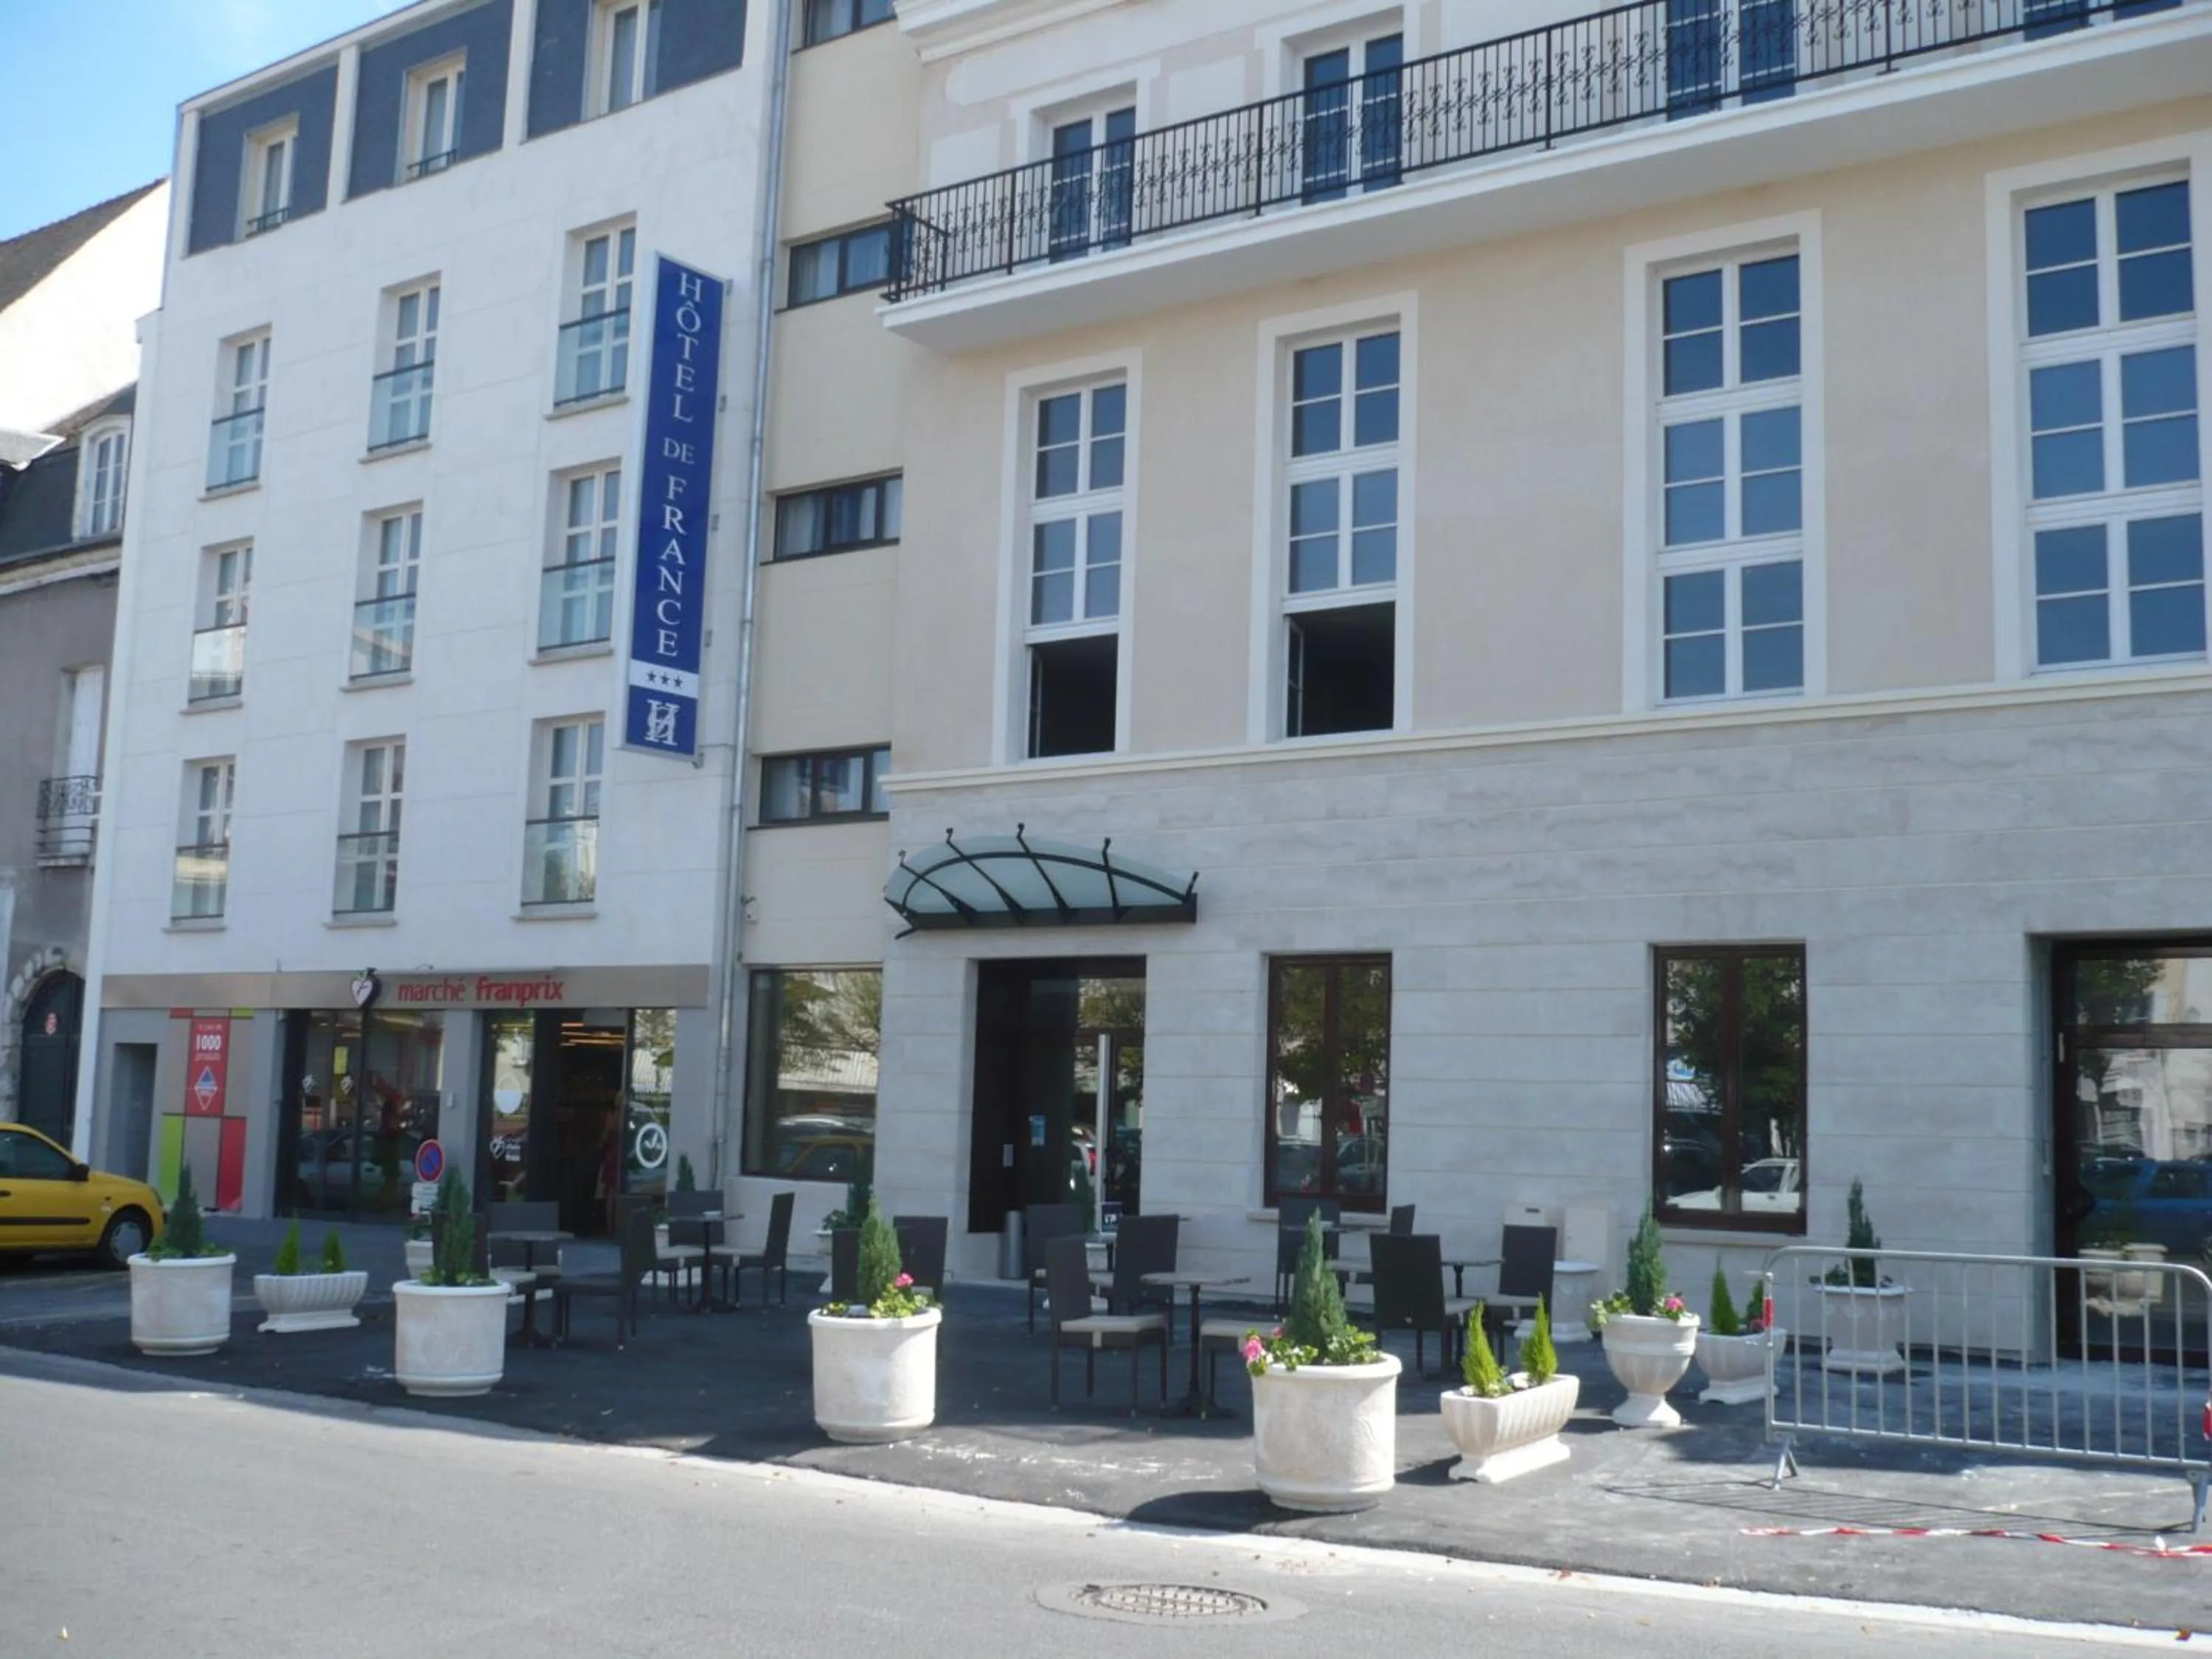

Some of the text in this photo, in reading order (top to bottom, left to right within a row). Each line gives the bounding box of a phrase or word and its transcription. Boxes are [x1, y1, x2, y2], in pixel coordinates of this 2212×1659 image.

[655, 272, 701, 658] HÔTEL DE FRANCE
[399, 974, 563, 1007] marché franprix
